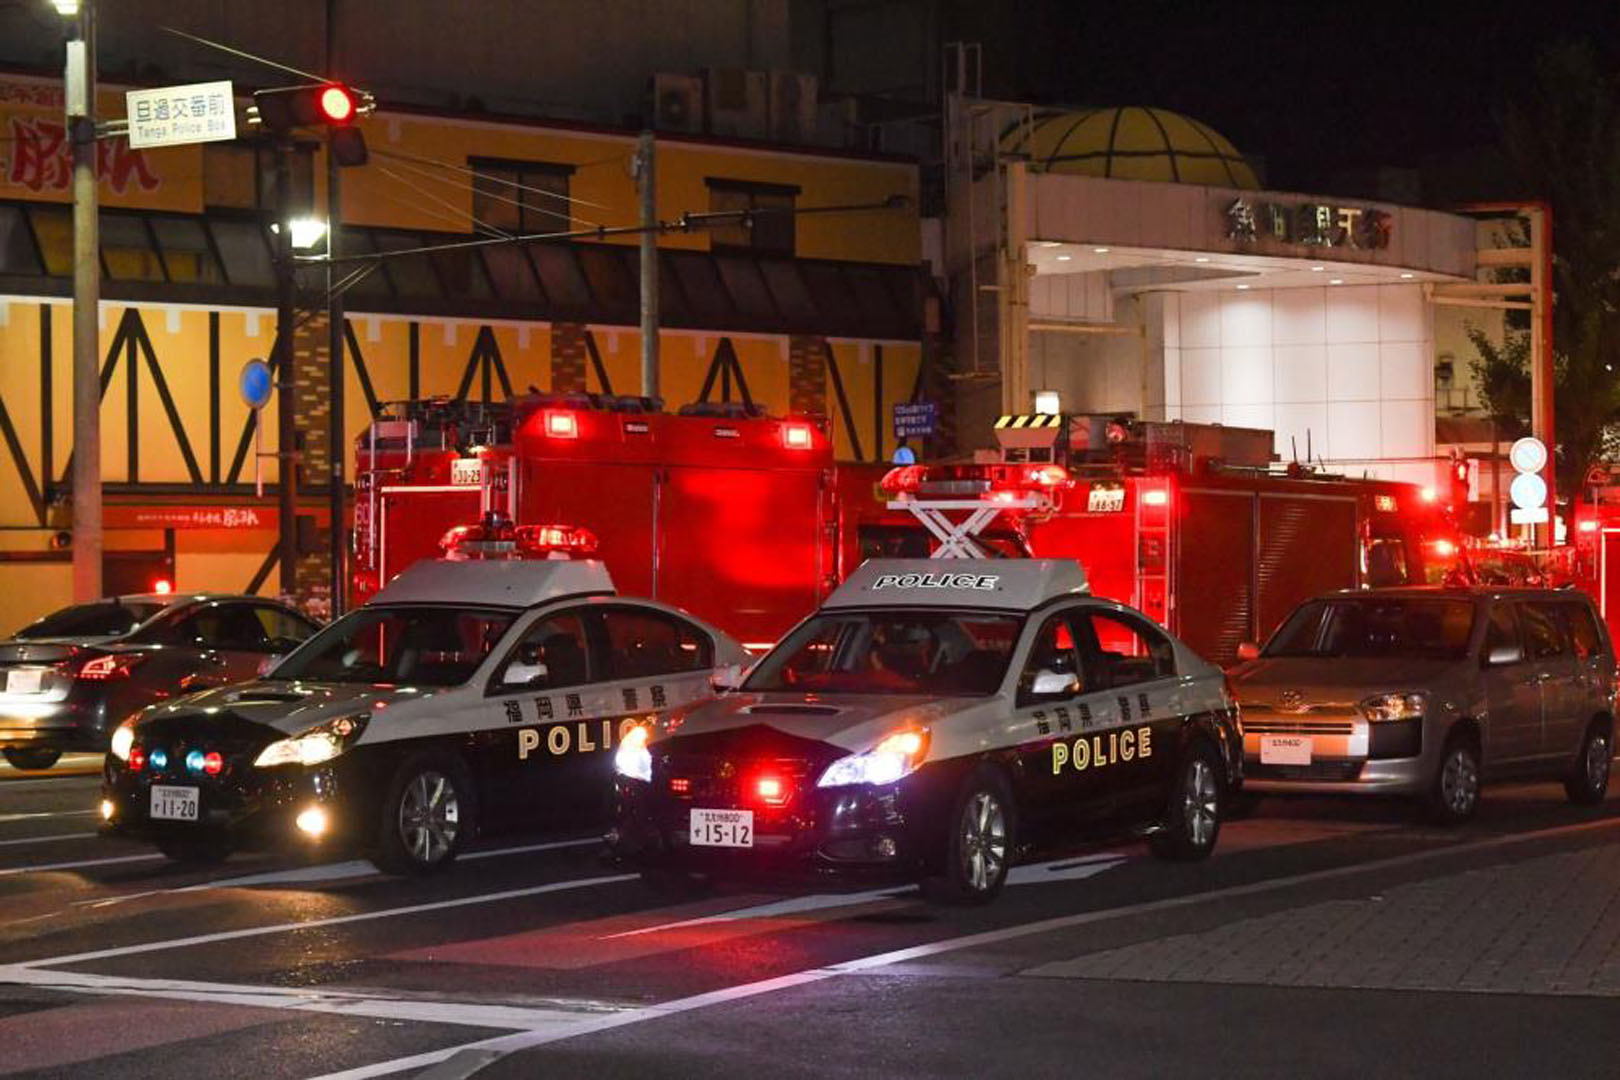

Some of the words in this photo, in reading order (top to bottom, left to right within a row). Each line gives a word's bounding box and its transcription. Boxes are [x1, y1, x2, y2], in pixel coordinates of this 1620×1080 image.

[136, 93, 225, 123] 旦過交番前
[873, 573, 999, 590] POLICE
[503, 693, 585, 724] 福岡県
[1052, 727, 1152, 775] POLICE
[163, 799, 196, 817] 11-20
[706, 824, 750, 845] 15-12
